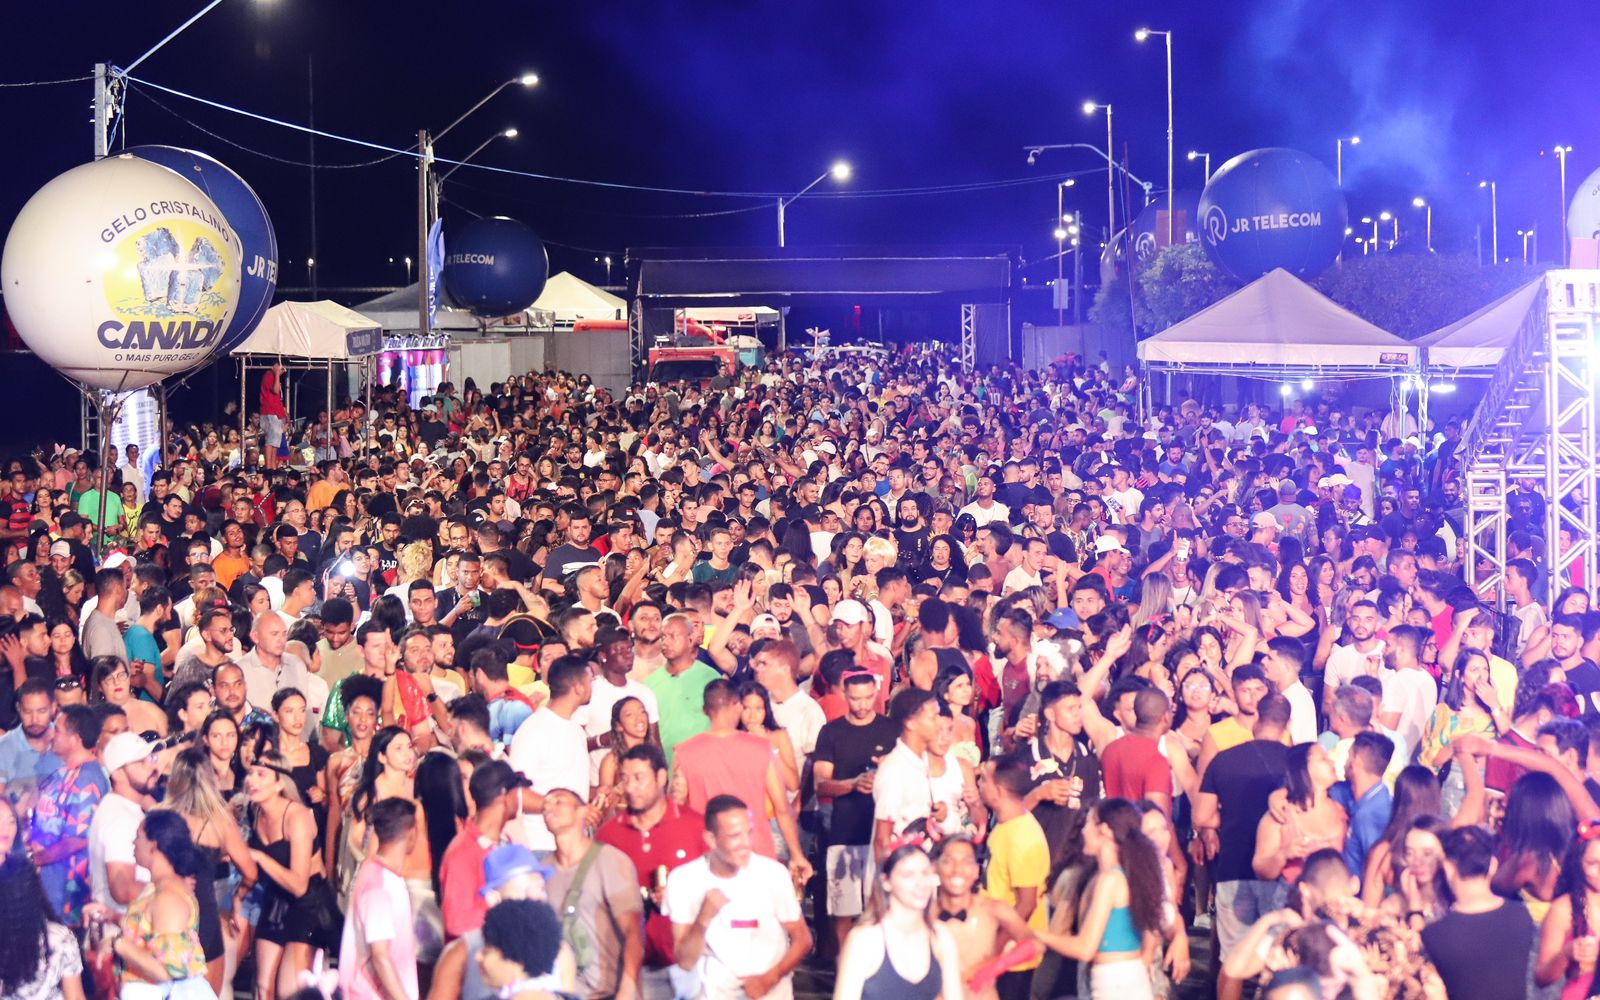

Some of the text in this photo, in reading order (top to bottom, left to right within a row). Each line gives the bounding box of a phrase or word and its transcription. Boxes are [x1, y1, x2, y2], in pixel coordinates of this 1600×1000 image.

[101, 200, 229, 243] GELO CRISTALINO
[1231, 212, 1321, 233] JR TELECOM
[247, 254, 265, 278] JR
[453, 253, 494, 265] TELECOM
[115, 353, 123, 362] O
[126, 353, 150, 362] MAIS
[152, 353, 178, 362] PURO
